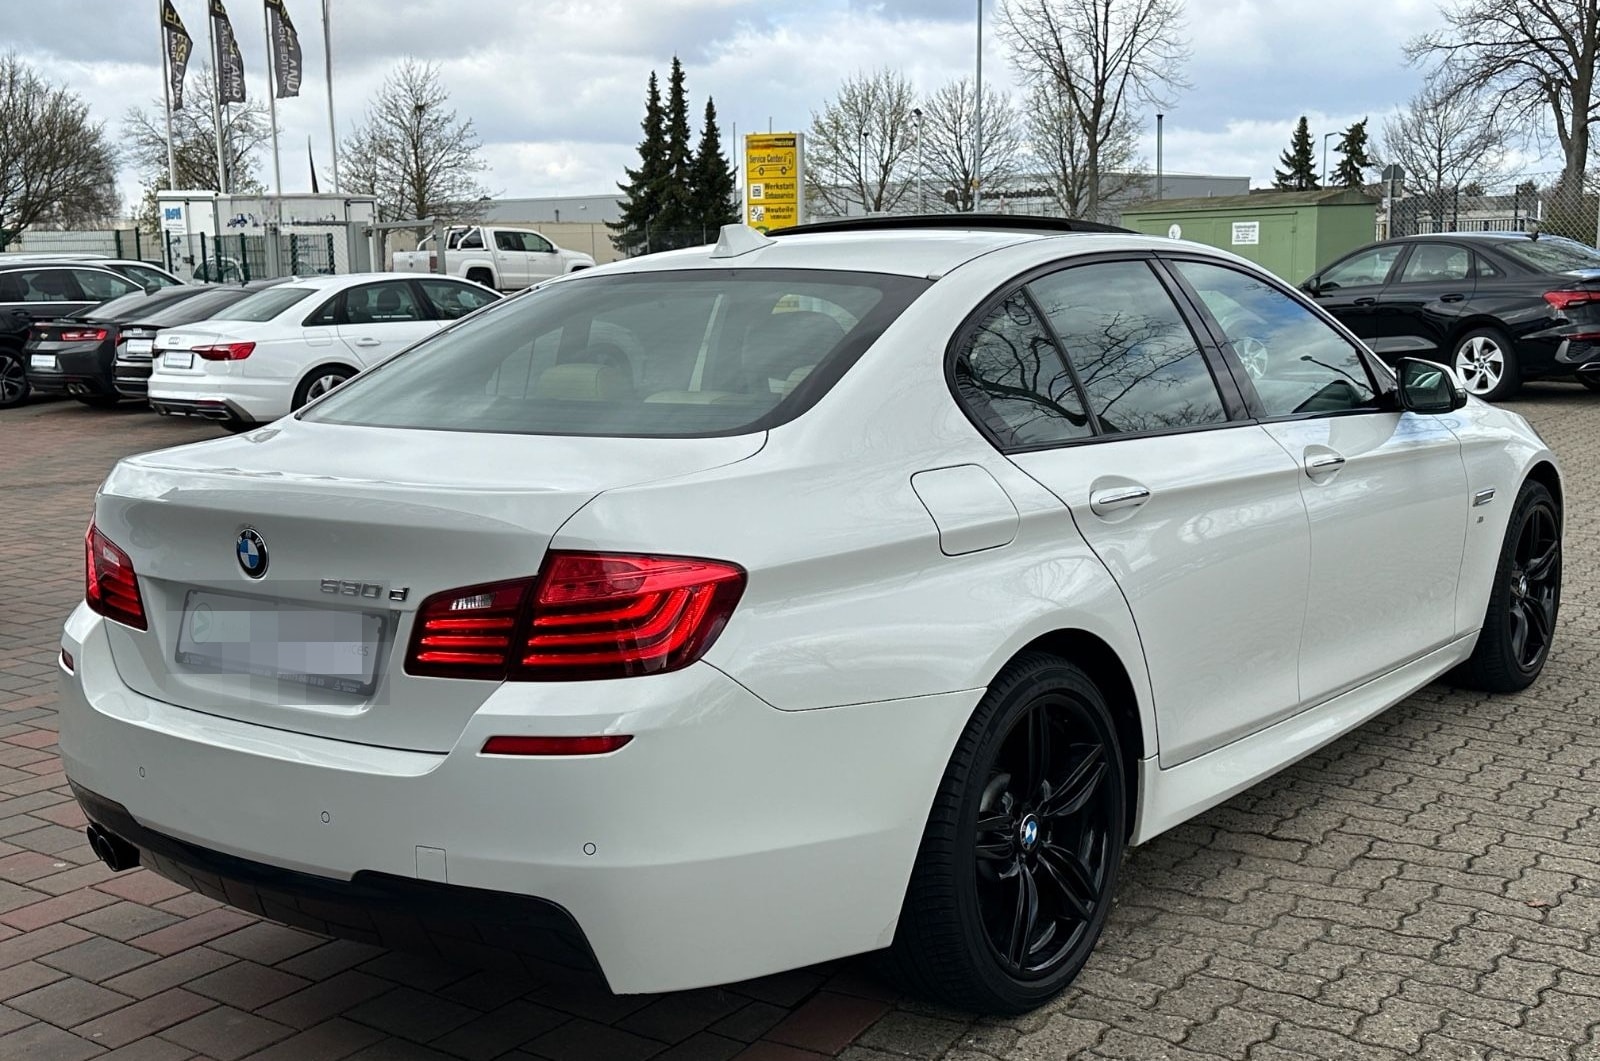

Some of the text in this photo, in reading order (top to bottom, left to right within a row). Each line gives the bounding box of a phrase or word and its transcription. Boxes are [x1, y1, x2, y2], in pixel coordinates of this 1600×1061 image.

[749, 153, 784, 164] Service Center
[320, 578, 410, 602] 530 d
